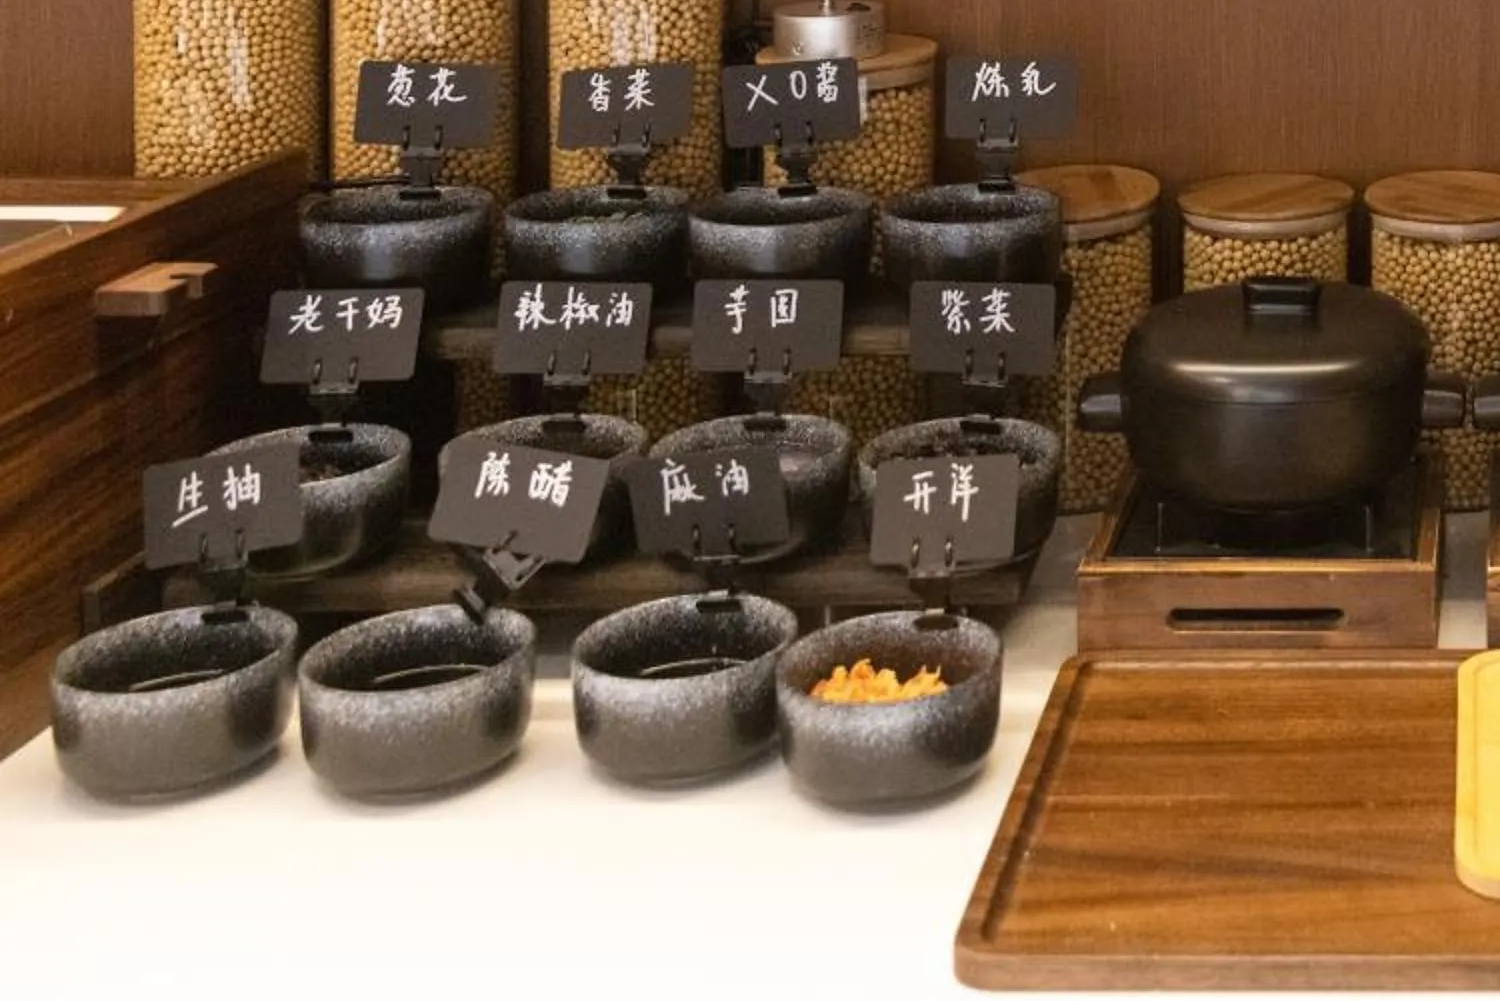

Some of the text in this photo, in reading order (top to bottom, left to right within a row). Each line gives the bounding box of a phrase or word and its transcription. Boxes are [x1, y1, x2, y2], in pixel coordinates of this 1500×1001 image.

[387, 63, 467, 107] 葱花
[582, 66, 655, 112] 香菜
[745, 58, 839, 111] XO酱
[289, 294, 403, 334] 老干妈
[514, 283, 634, 332] 辣椒油
[724, 284, 799, 334] 芋圆
[941, 287, 1015, 334] 紫菜
[172, 463, 261, 528] 生抽
[660, 458, 749, 515] 麻油
[903, 462, 979, 522] 开洋
